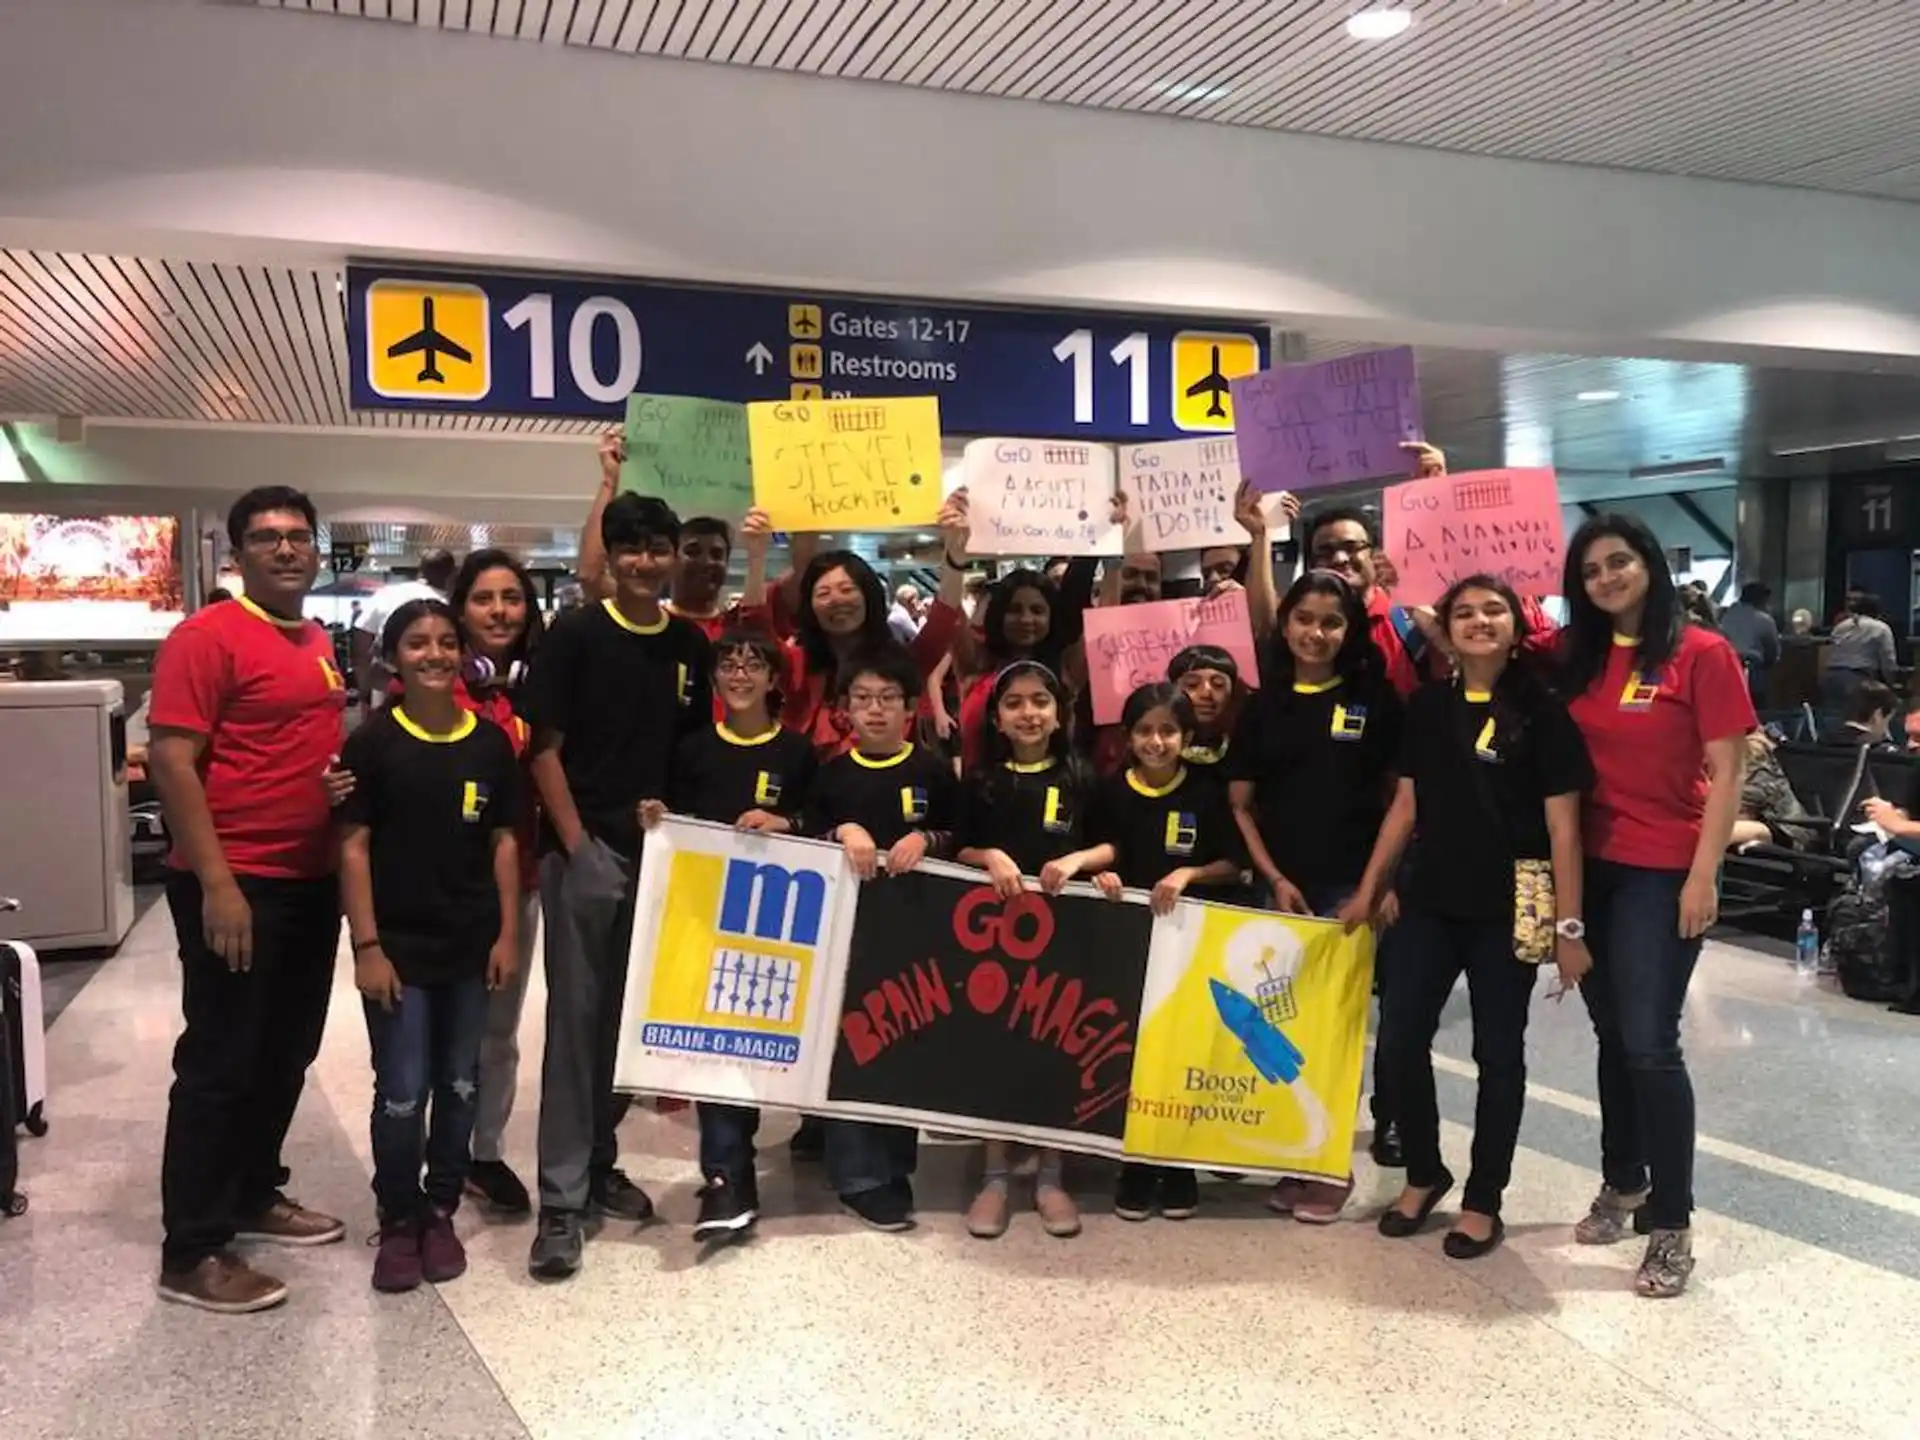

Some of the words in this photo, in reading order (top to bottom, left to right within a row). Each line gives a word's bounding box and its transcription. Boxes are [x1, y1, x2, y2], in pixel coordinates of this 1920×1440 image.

[829, 312, 899, 339] Gates
[907, 317, 970, 343] 12-17
[502, 293, 642, 404] 10
[830, 351, 957, 381] Restrooms
[1052, 328, 1149, 425] 11
[773, 403, 811, 422] GO
[1861, 497, 1892, 532] 11
[953, 886, 1055, 961] GO
[645, 1025, 797, 1061] BRAIN-O-MAGIC
[1185, 1067, 1257, 1095] Boost
